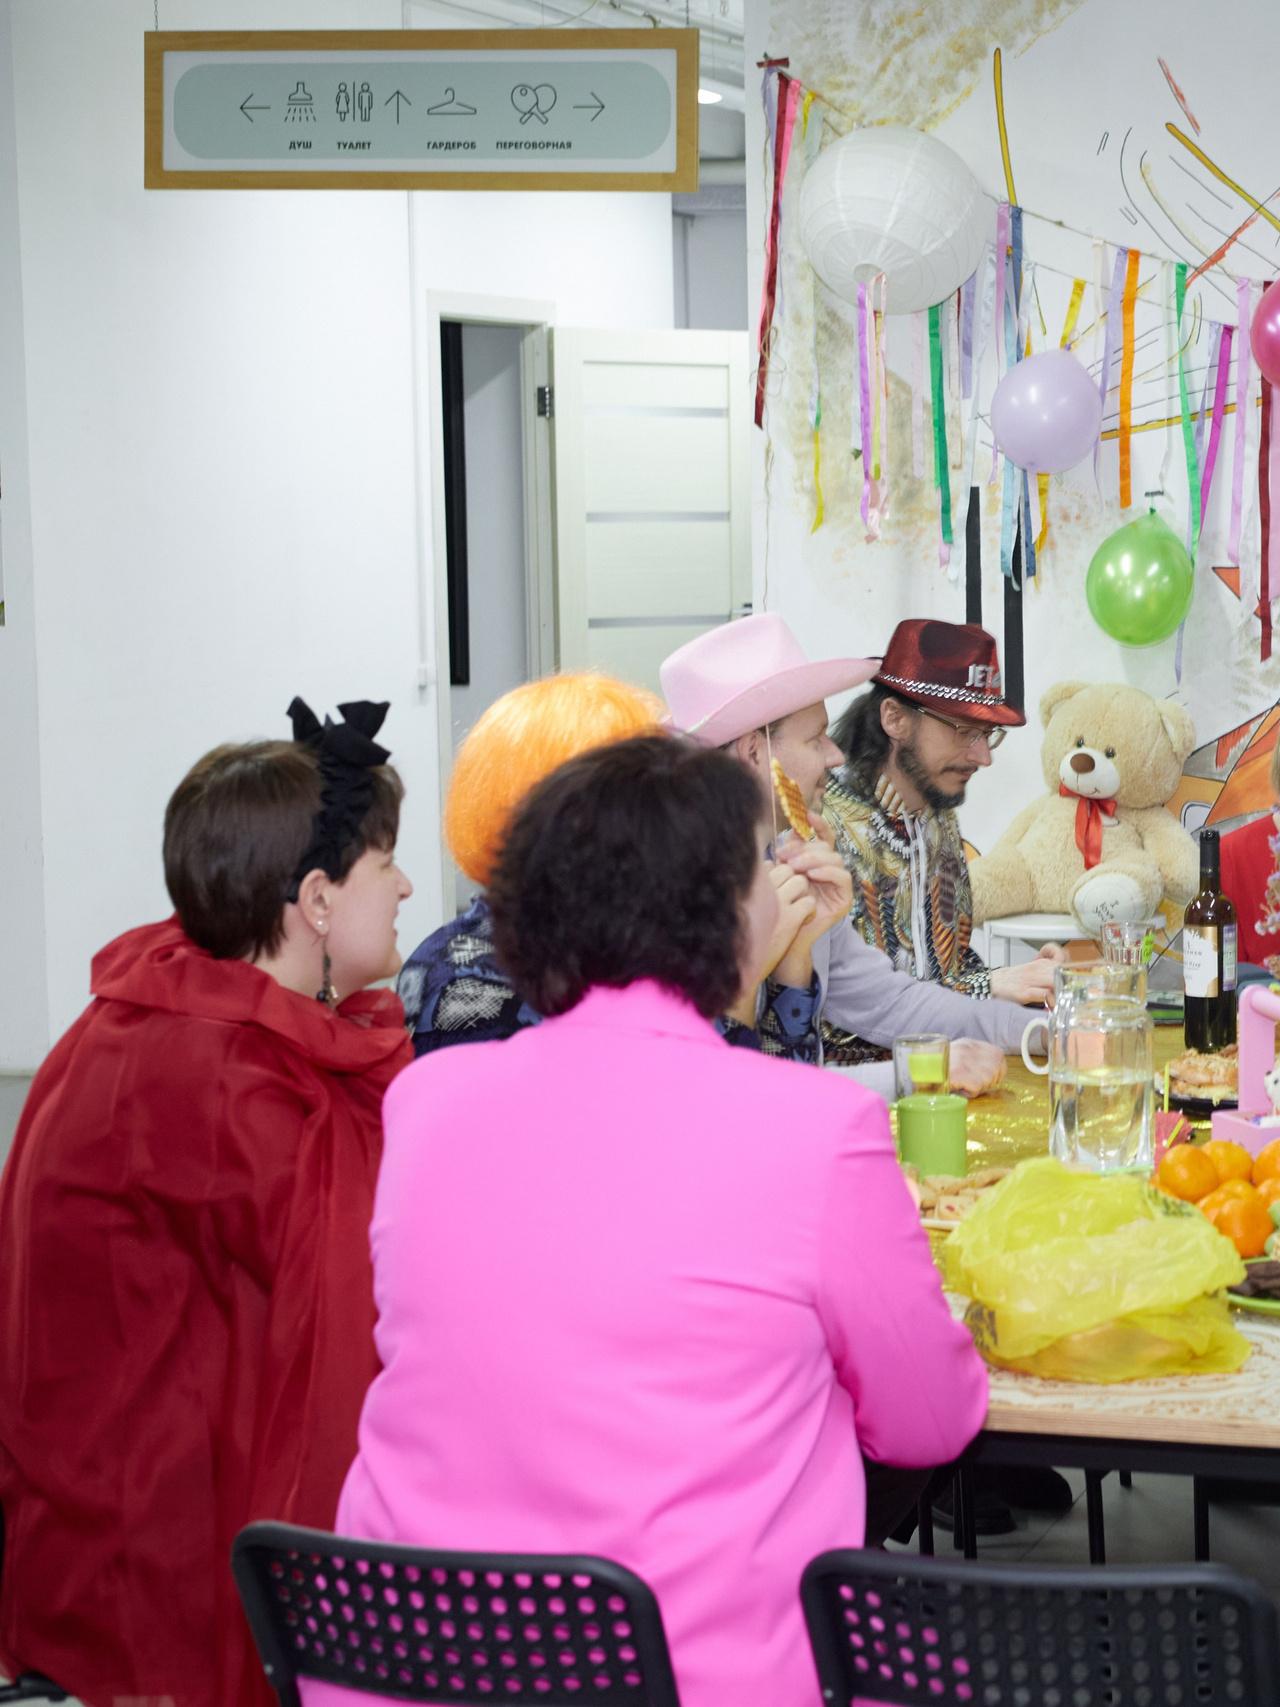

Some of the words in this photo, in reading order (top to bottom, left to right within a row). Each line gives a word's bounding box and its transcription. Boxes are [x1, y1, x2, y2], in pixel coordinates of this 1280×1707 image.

[288, 141, 312, 150] ДУШ
[337, 141, 371, 150] ТУАЛЕТ
[427, 141, 477, 151] ГАРДЕРОБ
[496, 141, 572, 150] ПЕРЕГОВОРНАЯ
